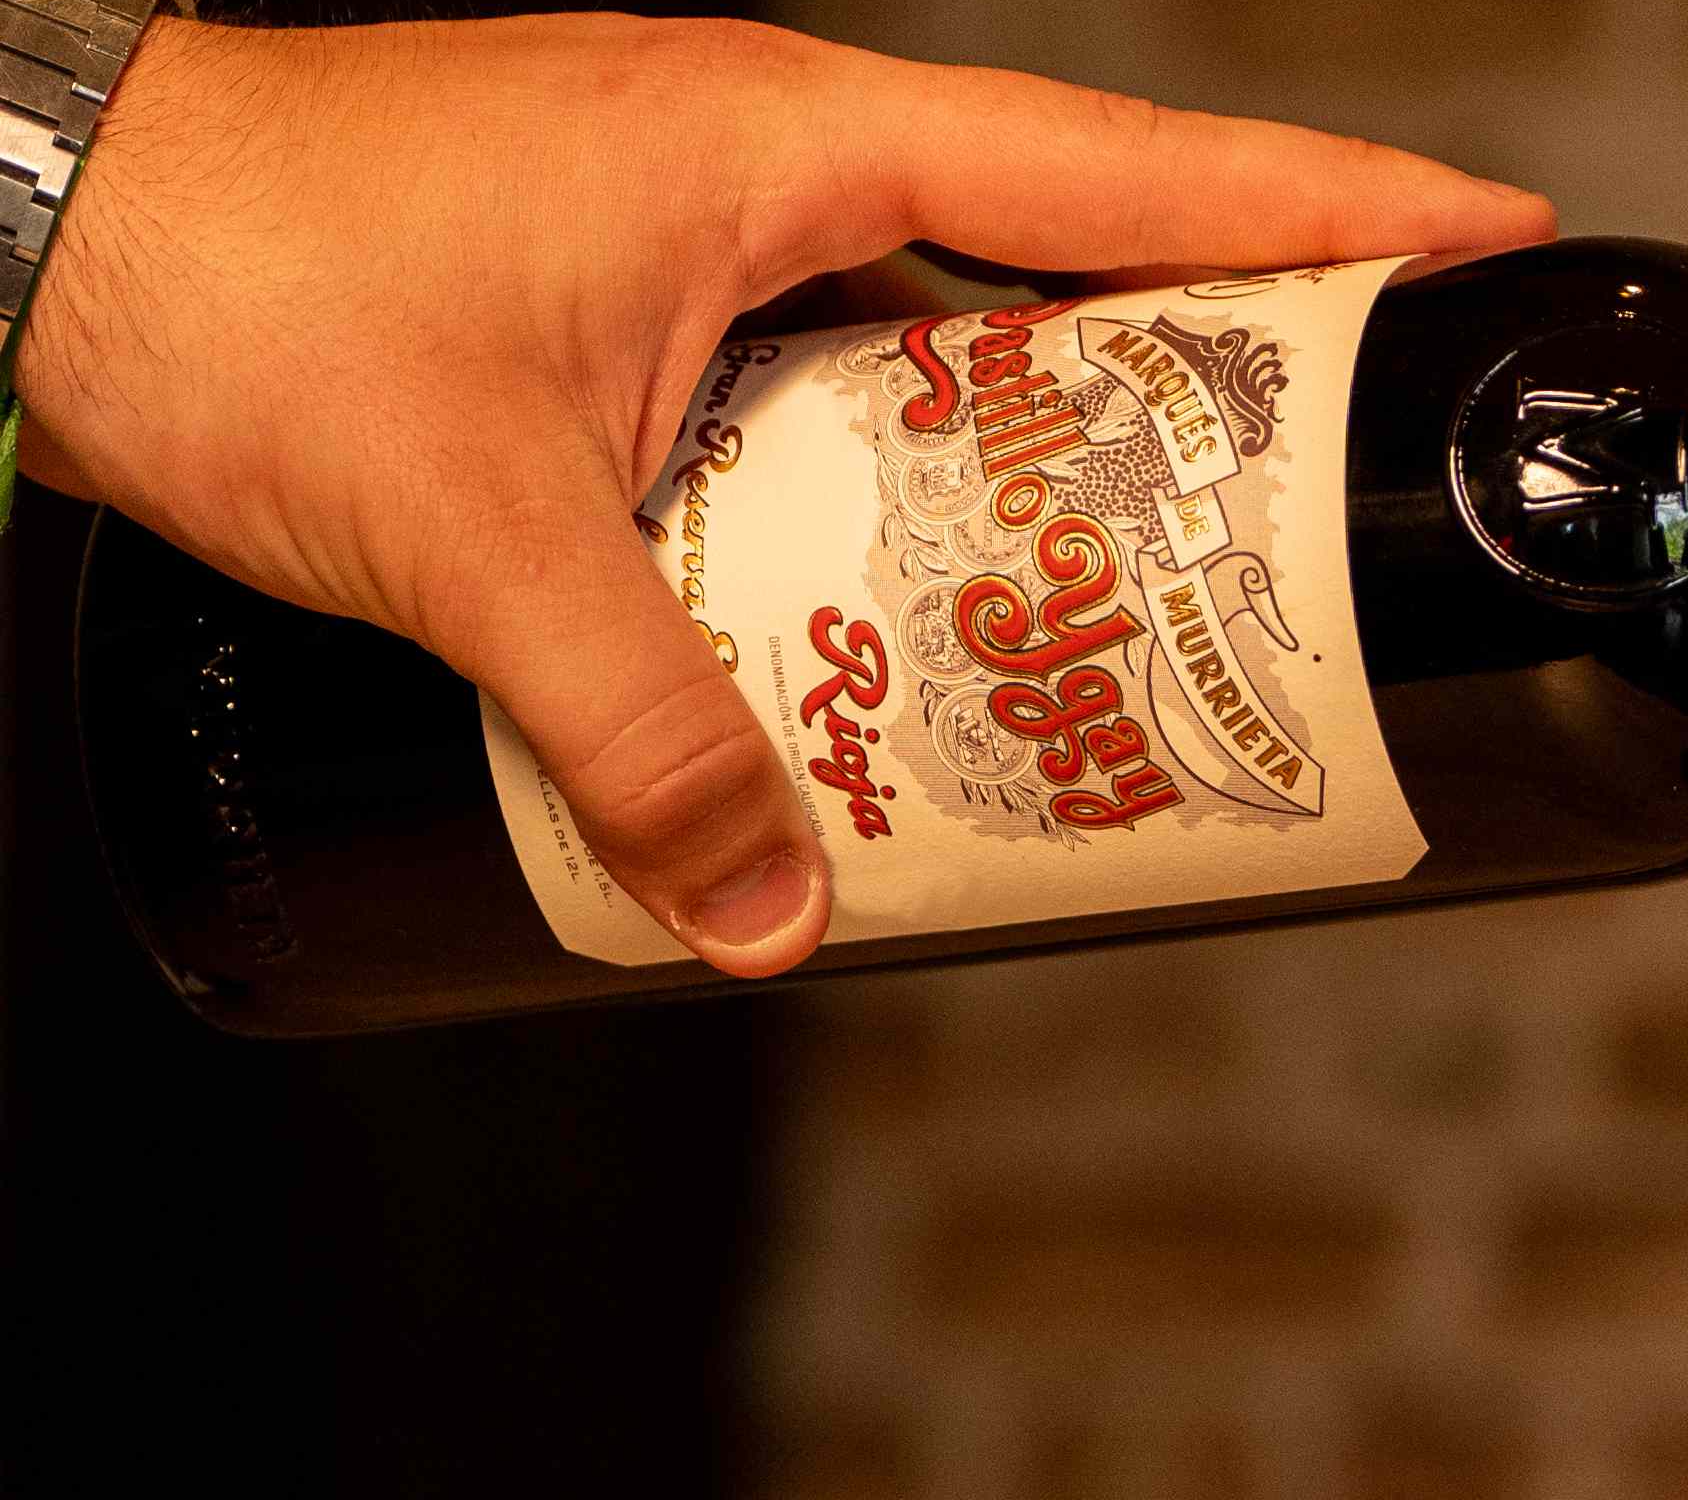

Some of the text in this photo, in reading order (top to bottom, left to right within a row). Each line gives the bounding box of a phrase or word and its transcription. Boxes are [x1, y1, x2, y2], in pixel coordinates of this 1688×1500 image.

[704, 343, 781, 413] Gran
[672, 417, 742, 610] Reserva
[1098, 329, 1298, 790] MARQUÉS DE MURRIETA
[768, 636, 826, 838] DENOMINACIÓN DE ORIGEN CALIFICADA
[800, 606, 897, 840] Rioja
[952, 512, 1186, 831] Ygay
[537, 767, 560, 823] ELLAS
[554, 828, 569, 851] DE
